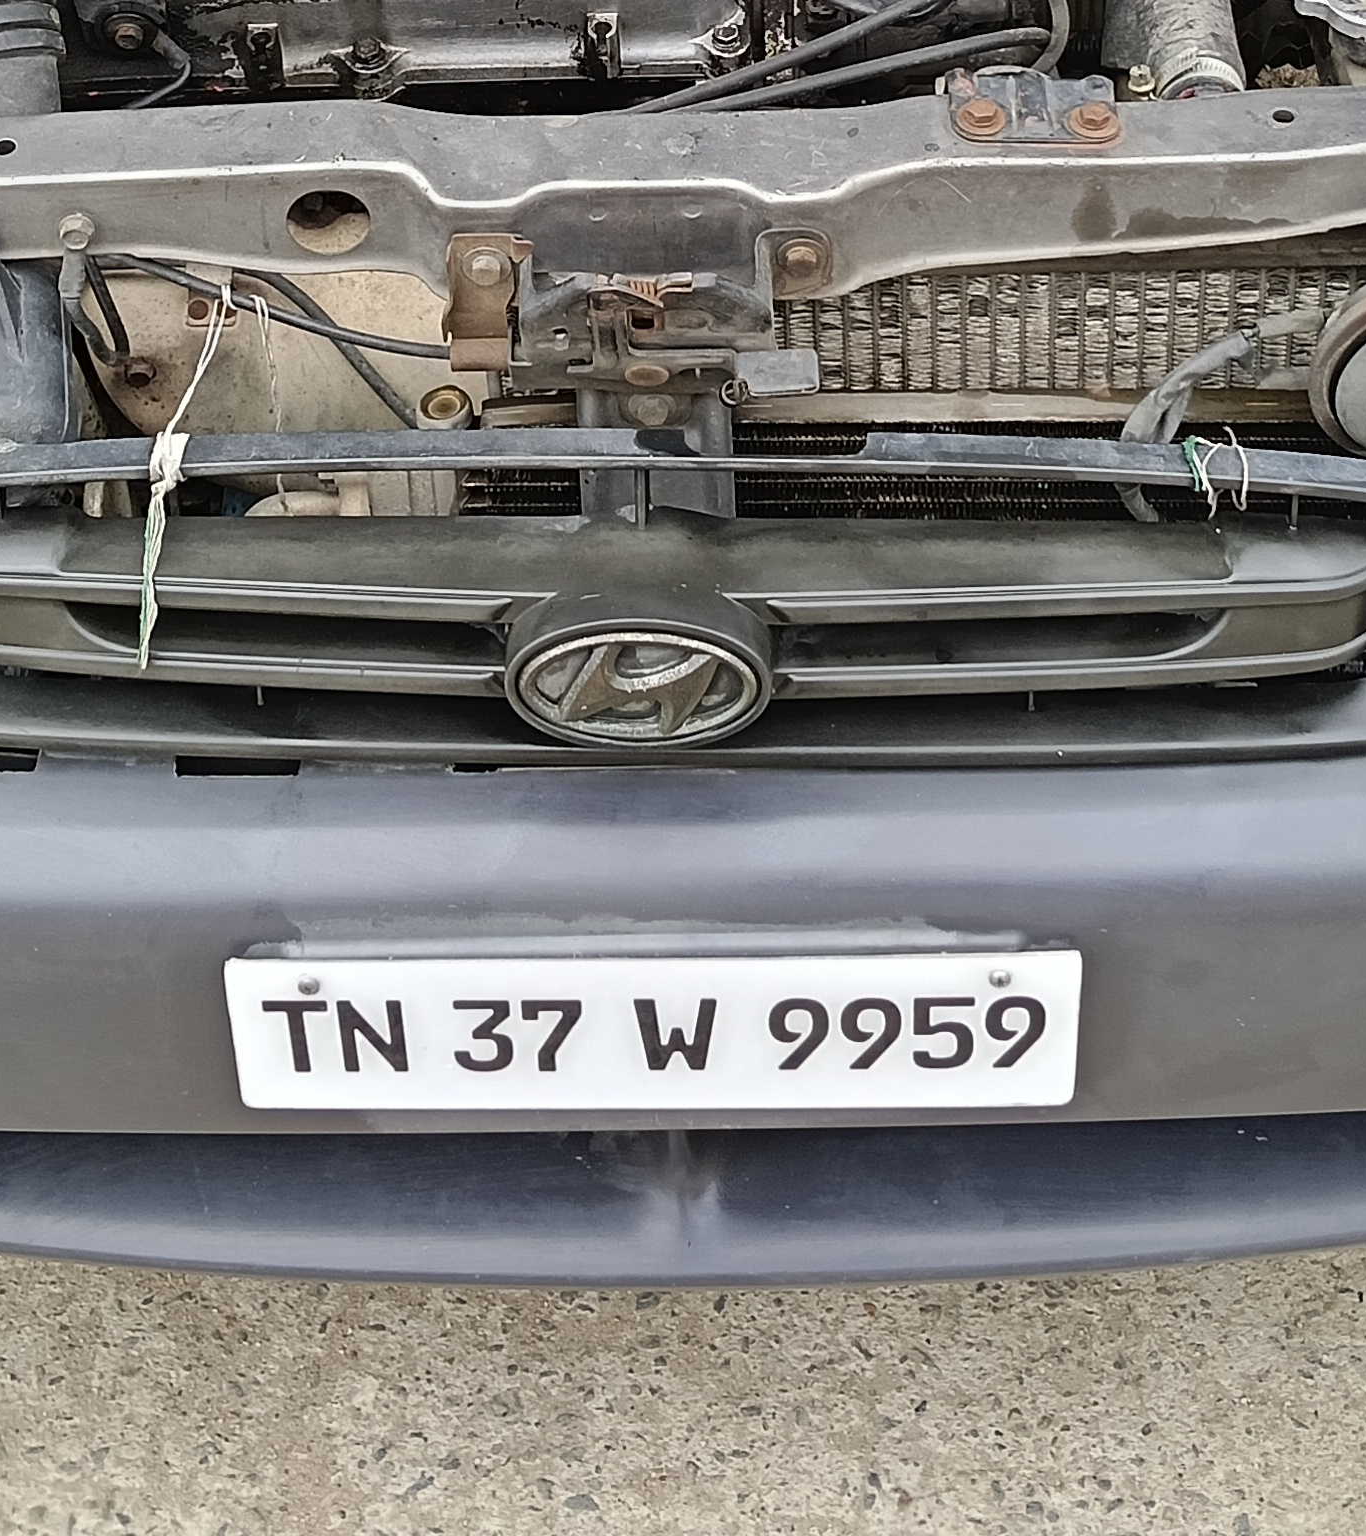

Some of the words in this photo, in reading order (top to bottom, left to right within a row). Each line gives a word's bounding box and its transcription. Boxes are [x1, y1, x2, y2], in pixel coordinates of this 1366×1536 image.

[261, 999, 410, 1074] TN
[452, 999, 583, 1073] 37
[633, 997, 718, 1071] W
[767, 996, 1047, 1071] 9959
